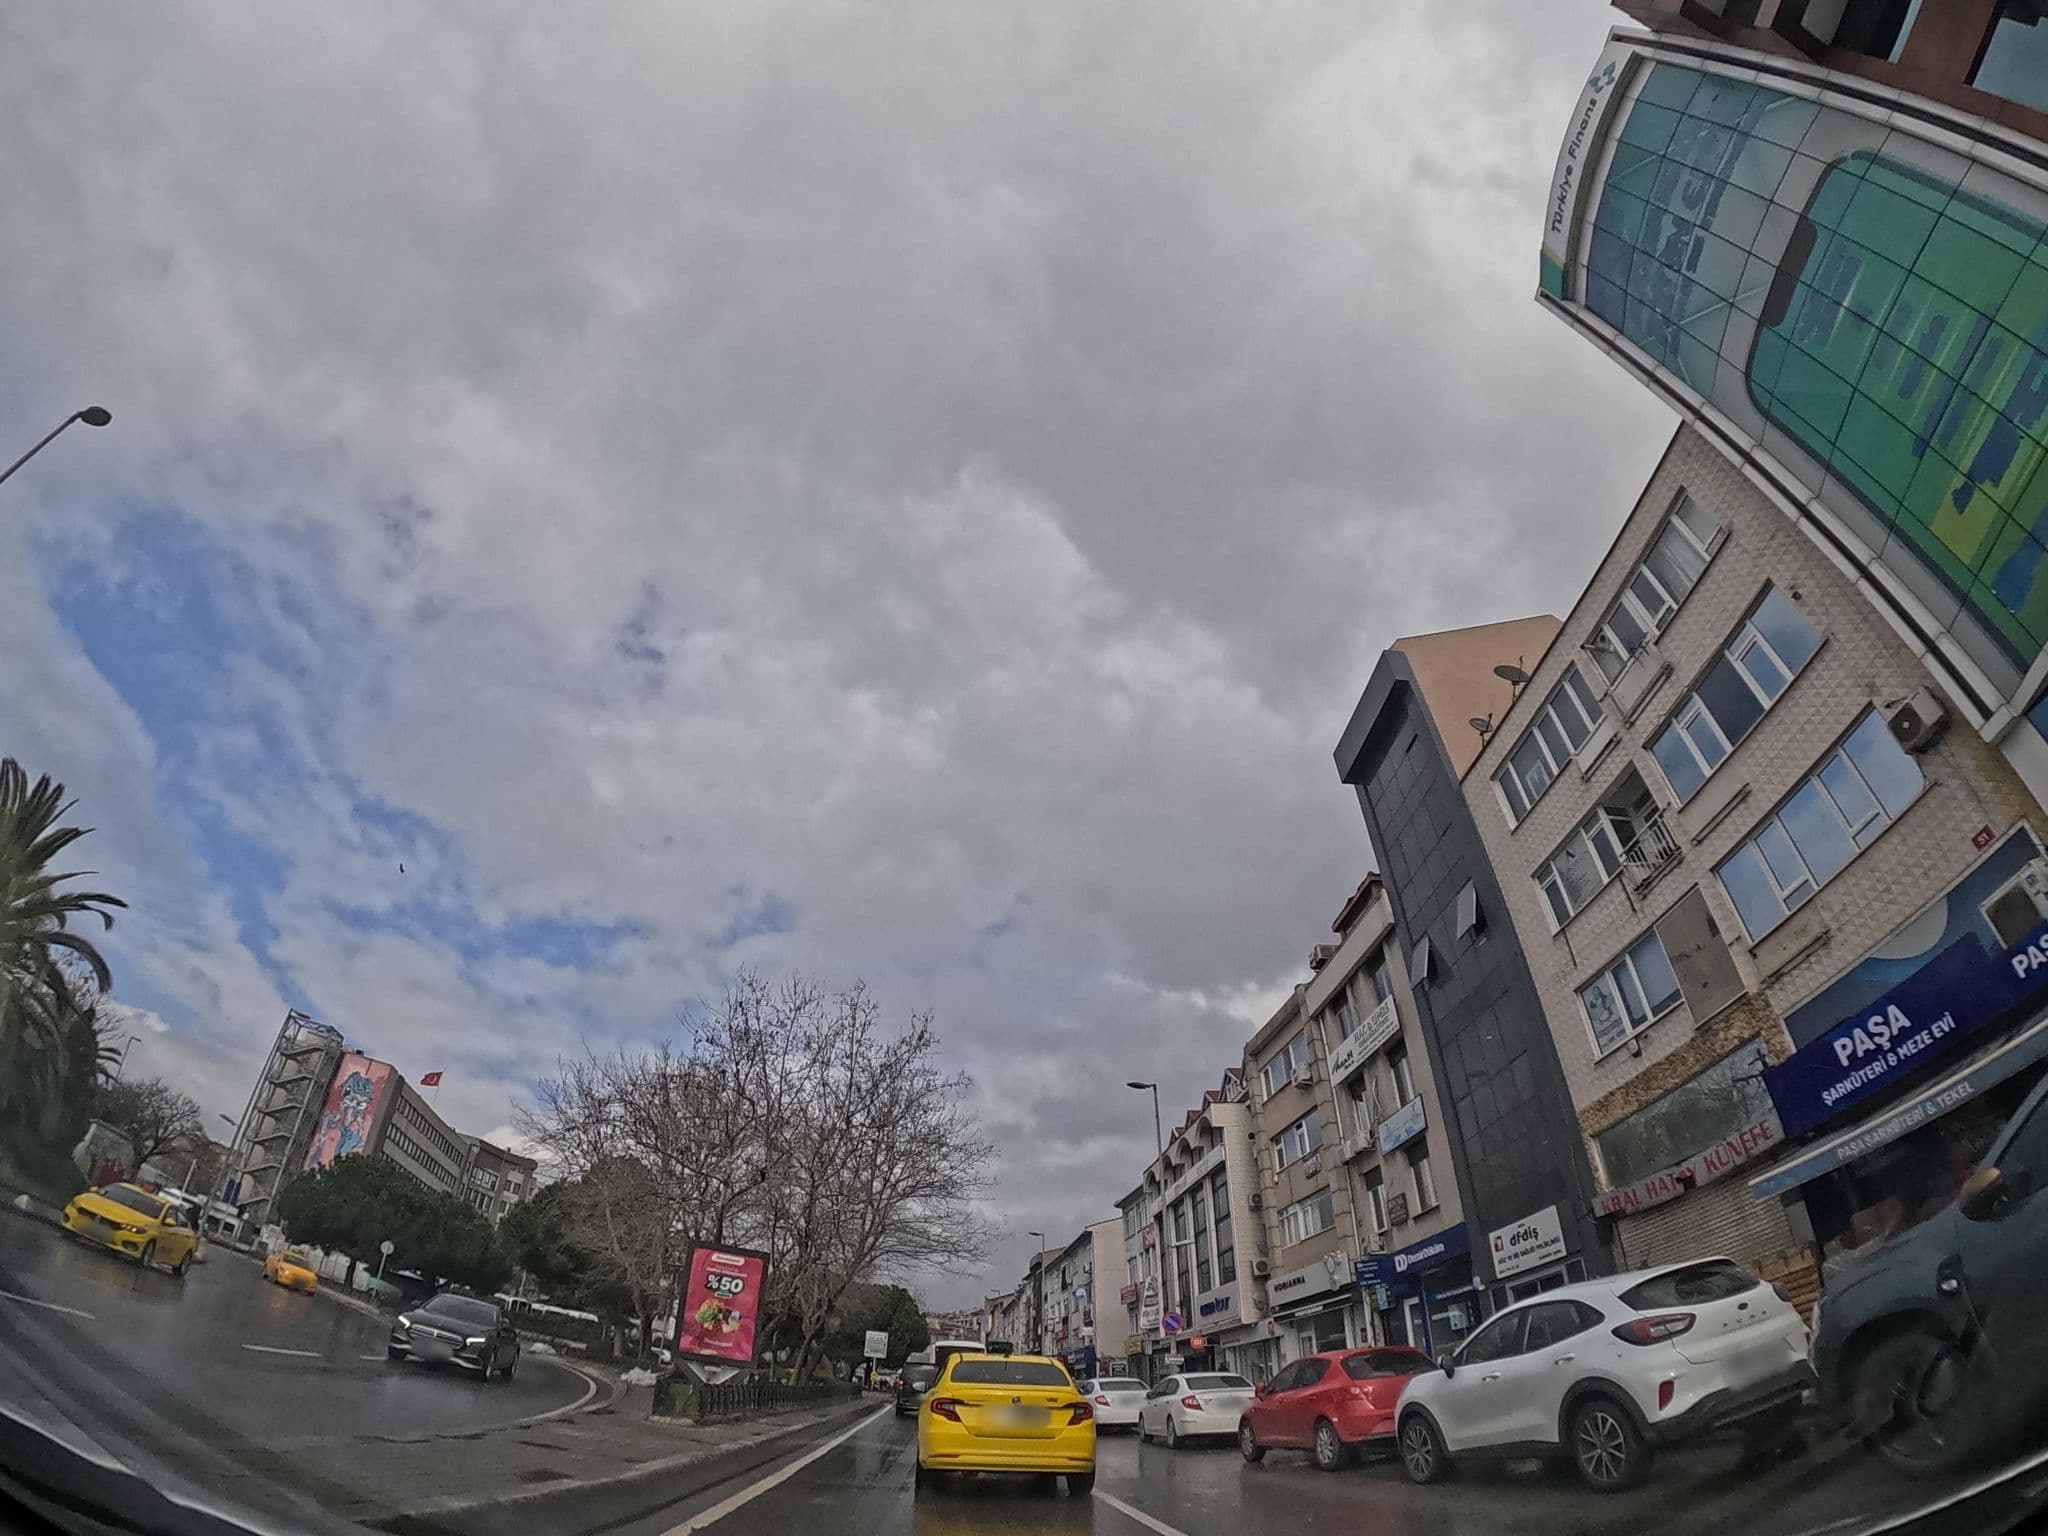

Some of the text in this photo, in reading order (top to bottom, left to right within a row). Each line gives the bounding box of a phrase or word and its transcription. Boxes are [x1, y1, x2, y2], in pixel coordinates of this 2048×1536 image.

[1551, 98, 1598, 233] Türkiye Finans
[1833, 1004, 1912, 1067] PAŞA
[1822, 1011, 1956, 1106] ŞARKÜTERİ & MEZE EVİ
[1936, 1081, 1975, 1108] TEKEL
[1509, 1226, 1539, 1246] dfdiş
[707, 1274, 743, 1293] %50
